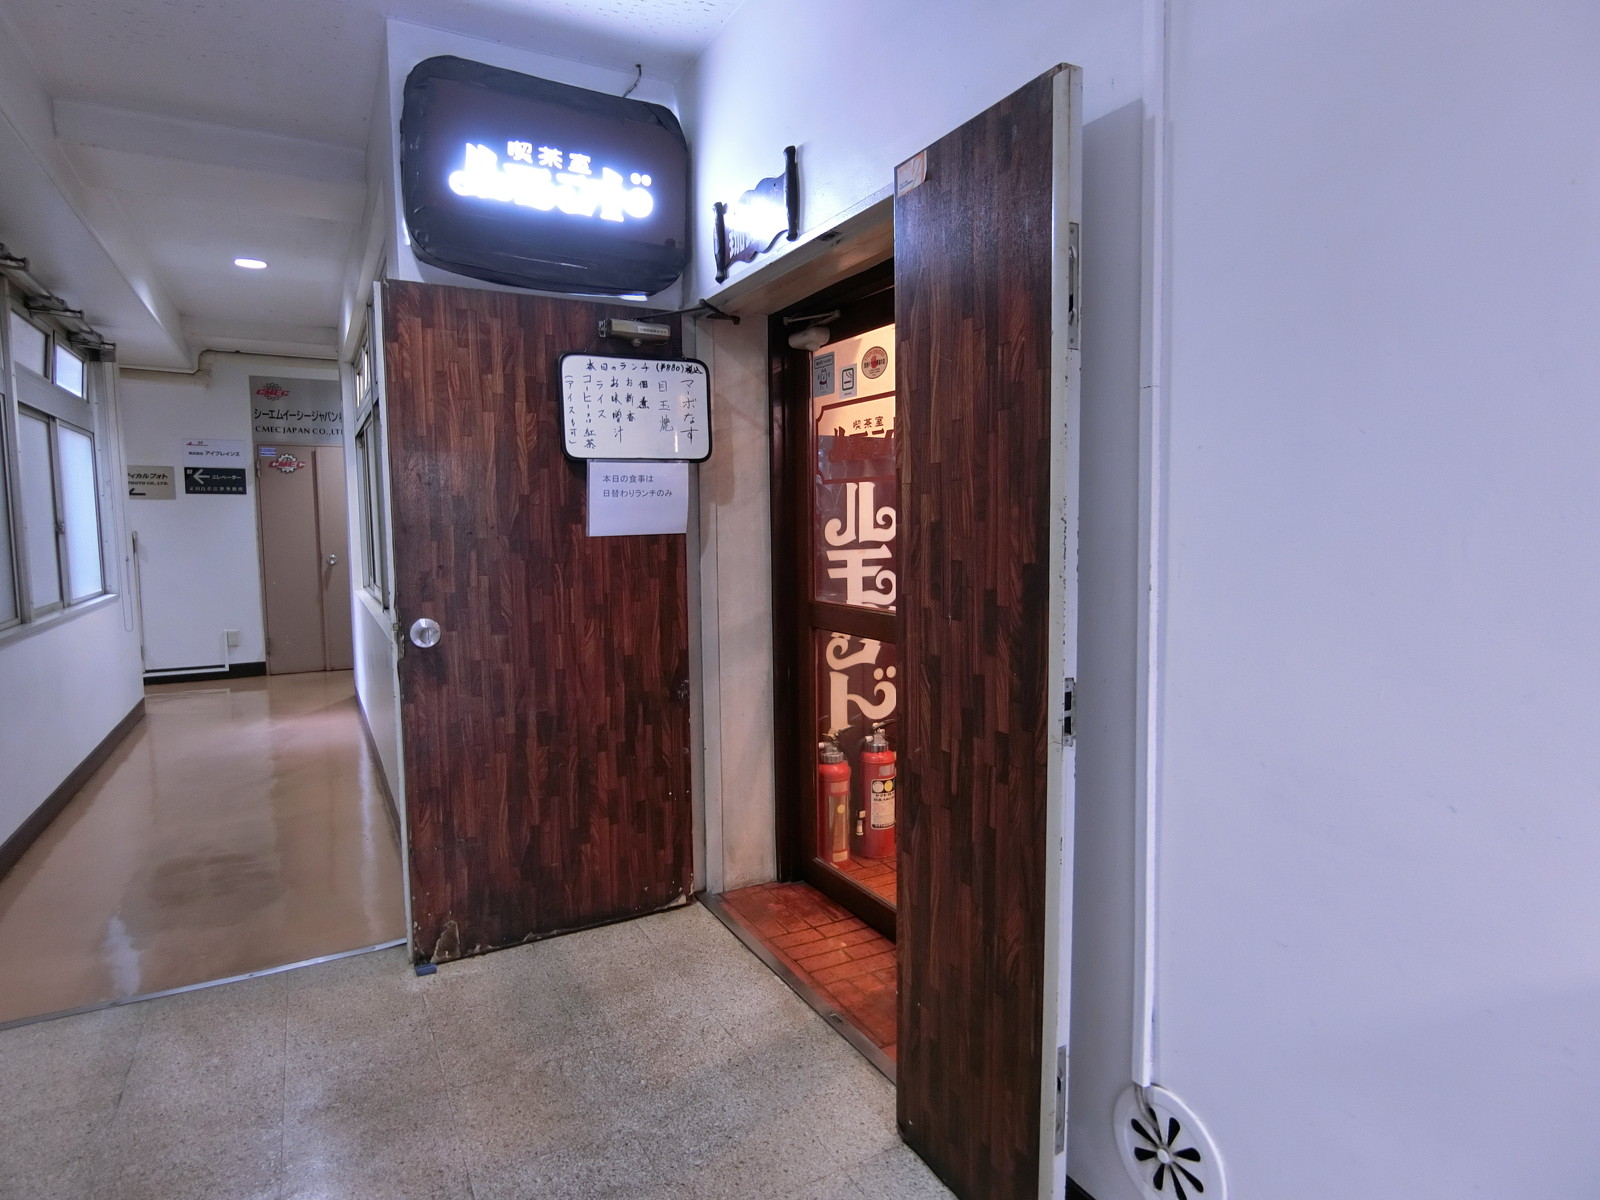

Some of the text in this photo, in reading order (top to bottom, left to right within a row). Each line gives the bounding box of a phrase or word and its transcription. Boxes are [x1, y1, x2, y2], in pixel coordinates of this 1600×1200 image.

[507, 141, 592, 175] 喫茶室
[586, 359, 650, 373] 本日のランチ
[256, 388, 291, 397] CMEC
[596, 380, 607, 419] ライス
[625, 378, 636, 422] お新香
[611, 376, 624, 443] お味噌汁
[659, 381, 674, 432] 目玉焼
[681, 380, 699, 445] マーボなす
[255, 425, 343, 436] CMEC JAPAN CO.,LT
[852, 415, 884, 431] 喫茶室
[602, 474, 655, 484] 本日の食事は
[603, 489, 673, 498] 日替わりランチのみ
